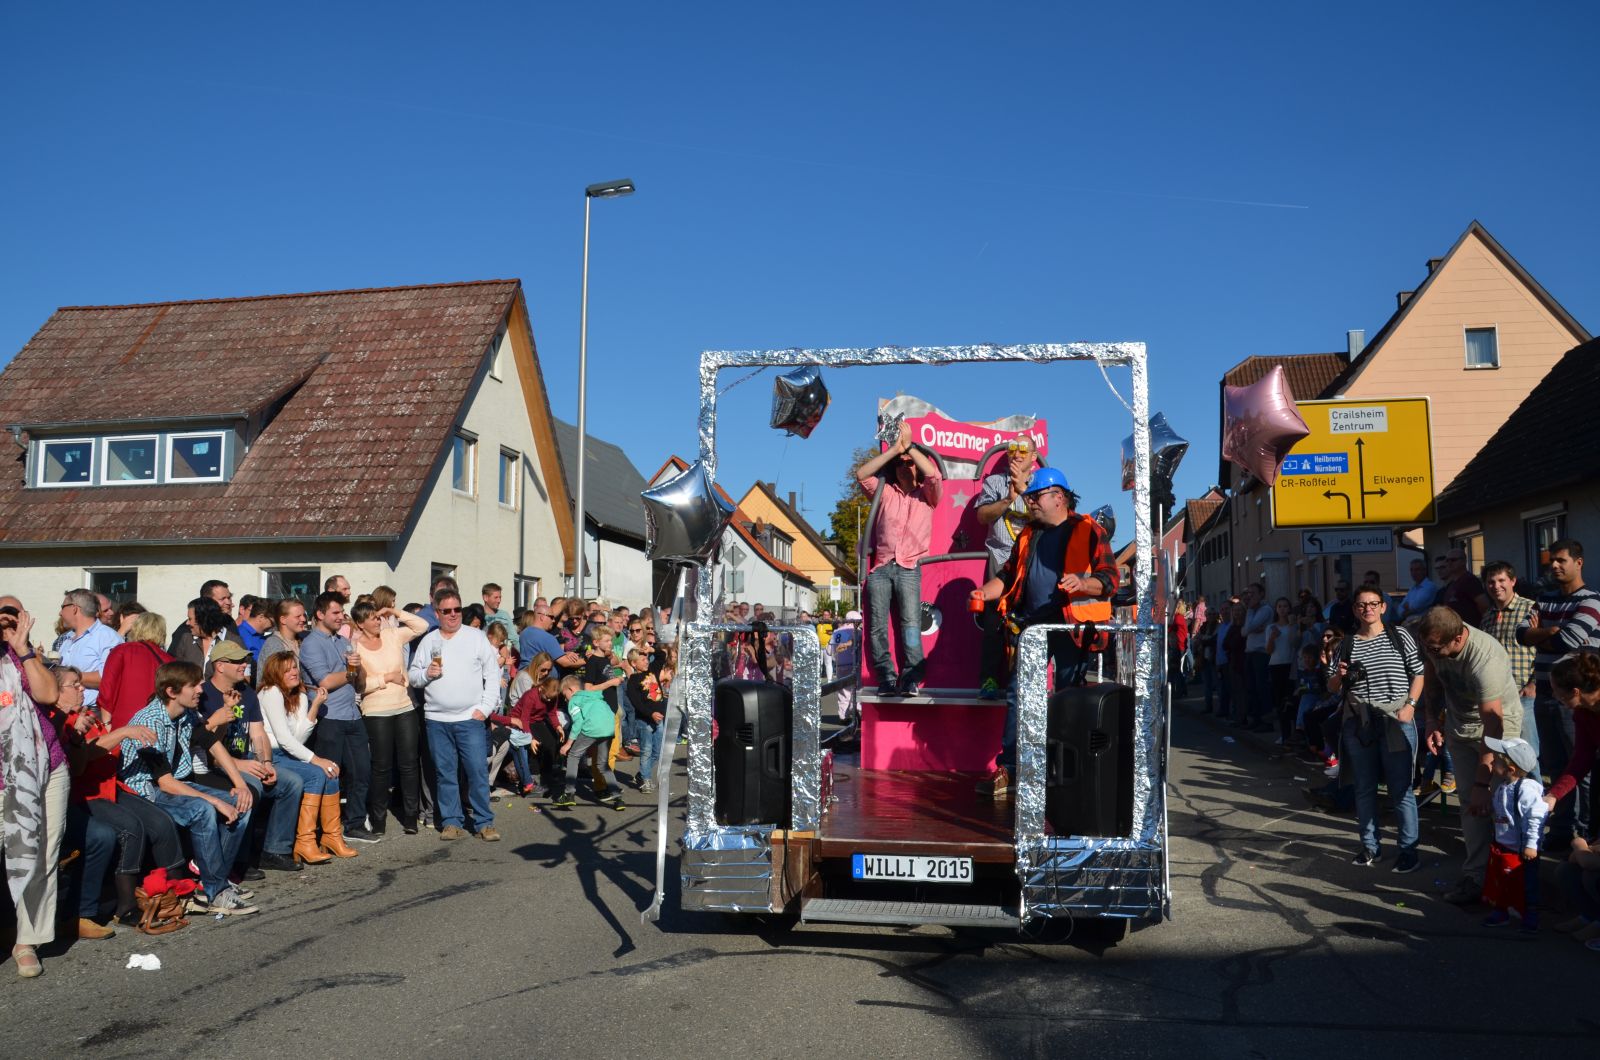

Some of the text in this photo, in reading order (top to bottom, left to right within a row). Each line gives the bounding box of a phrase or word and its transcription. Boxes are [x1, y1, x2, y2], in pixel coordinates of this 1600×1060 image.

[1332, 409, 1384, 420] Crailsheim
[1333, 421, 1374, 431] Zentrum
[921, 424, 989, 453] Onzamer
[1315, 464, 1342, 473] Nürnberg
[1281, 477, 1336, 488] CR-Roßfeld
[1373, 474, 1425, 484] Ellwangen
[1341, 536, 1387, 547] parc vital
[865, 858, 915, 878] WILLI
[927, 859, 970, 879] 2015
